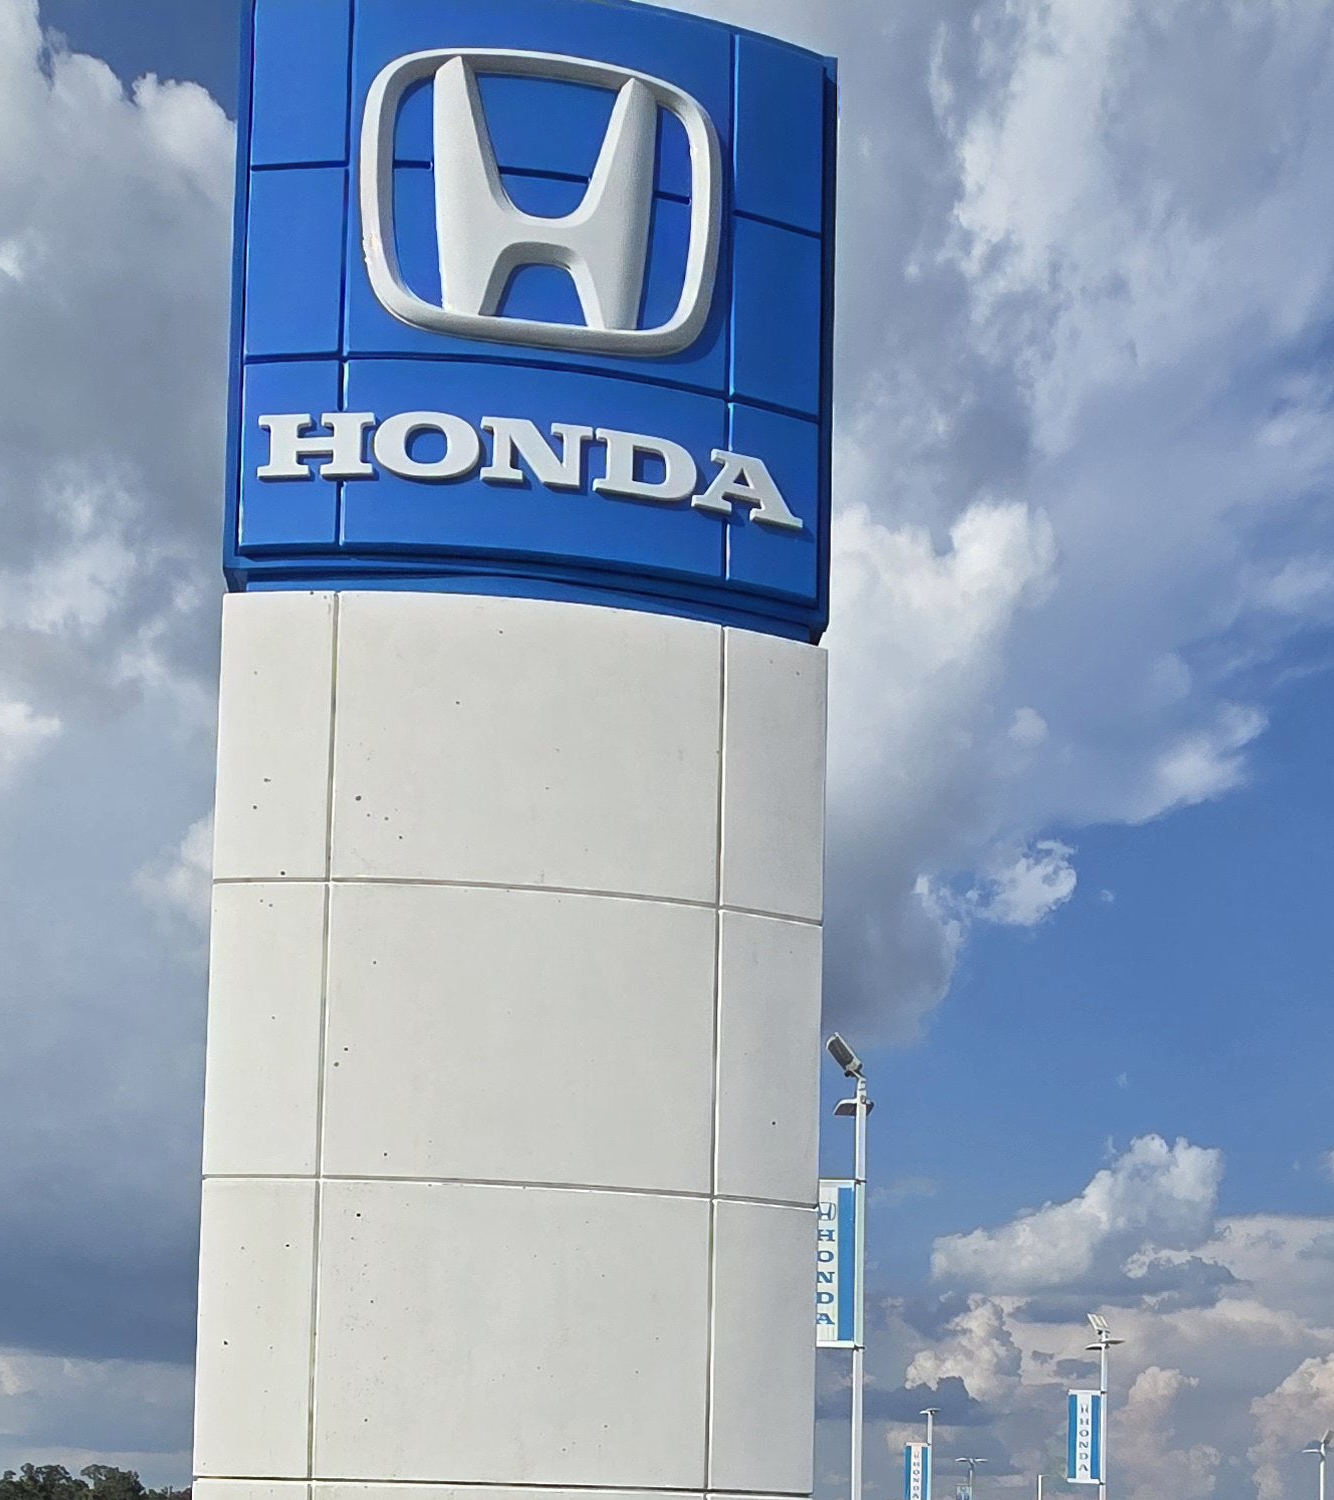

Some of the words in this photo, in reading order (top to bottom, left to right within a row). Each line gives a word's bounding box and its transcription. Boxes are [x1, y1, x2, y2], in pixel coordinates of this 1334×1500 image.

[256, 411, 804, 530] HONDA
[817, 1229, 835, 1325] HONDA
[912, 1461, 920, 1499] HONDA
[1078, 1418, 1089, 1471] HONDA
